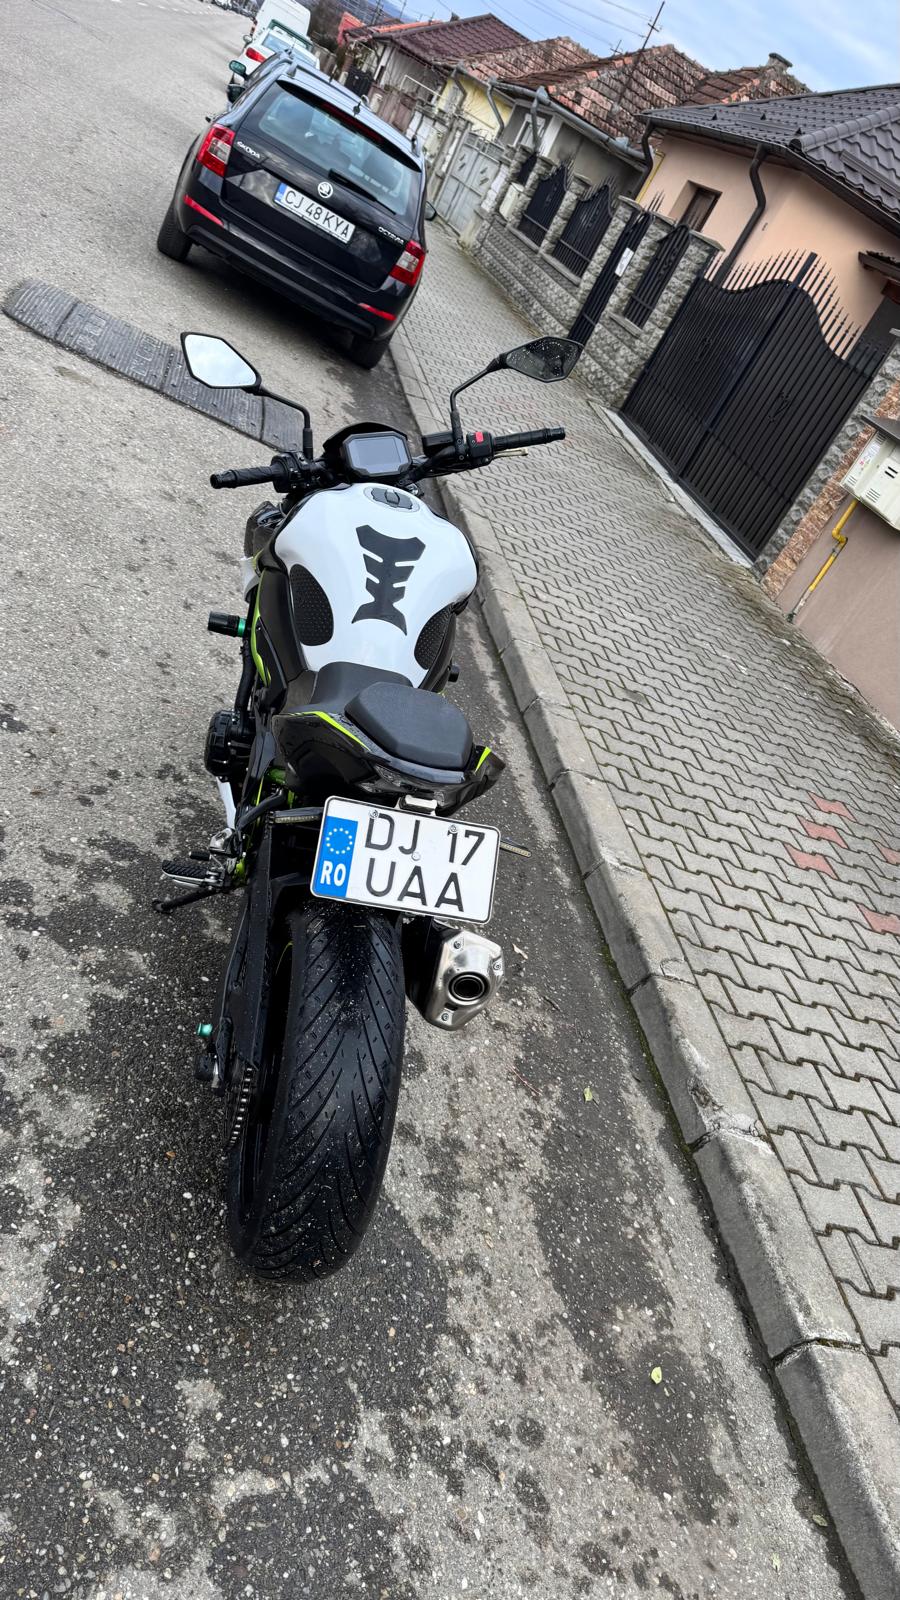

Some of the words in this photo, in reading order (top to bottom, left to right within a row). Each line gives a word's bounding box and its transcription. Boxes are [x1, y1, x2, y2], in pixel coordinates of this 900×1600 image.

[285, 190, 304, 209] CJ
[305, 202, 323, 221] 48
[322, 211, 350, 238] KYA
[365, 812, 420, 855] DJ
[447, 827, 486, 866] 17
[320, 860, 347, 887] RO
[365, 857, 465, 913] UAA
